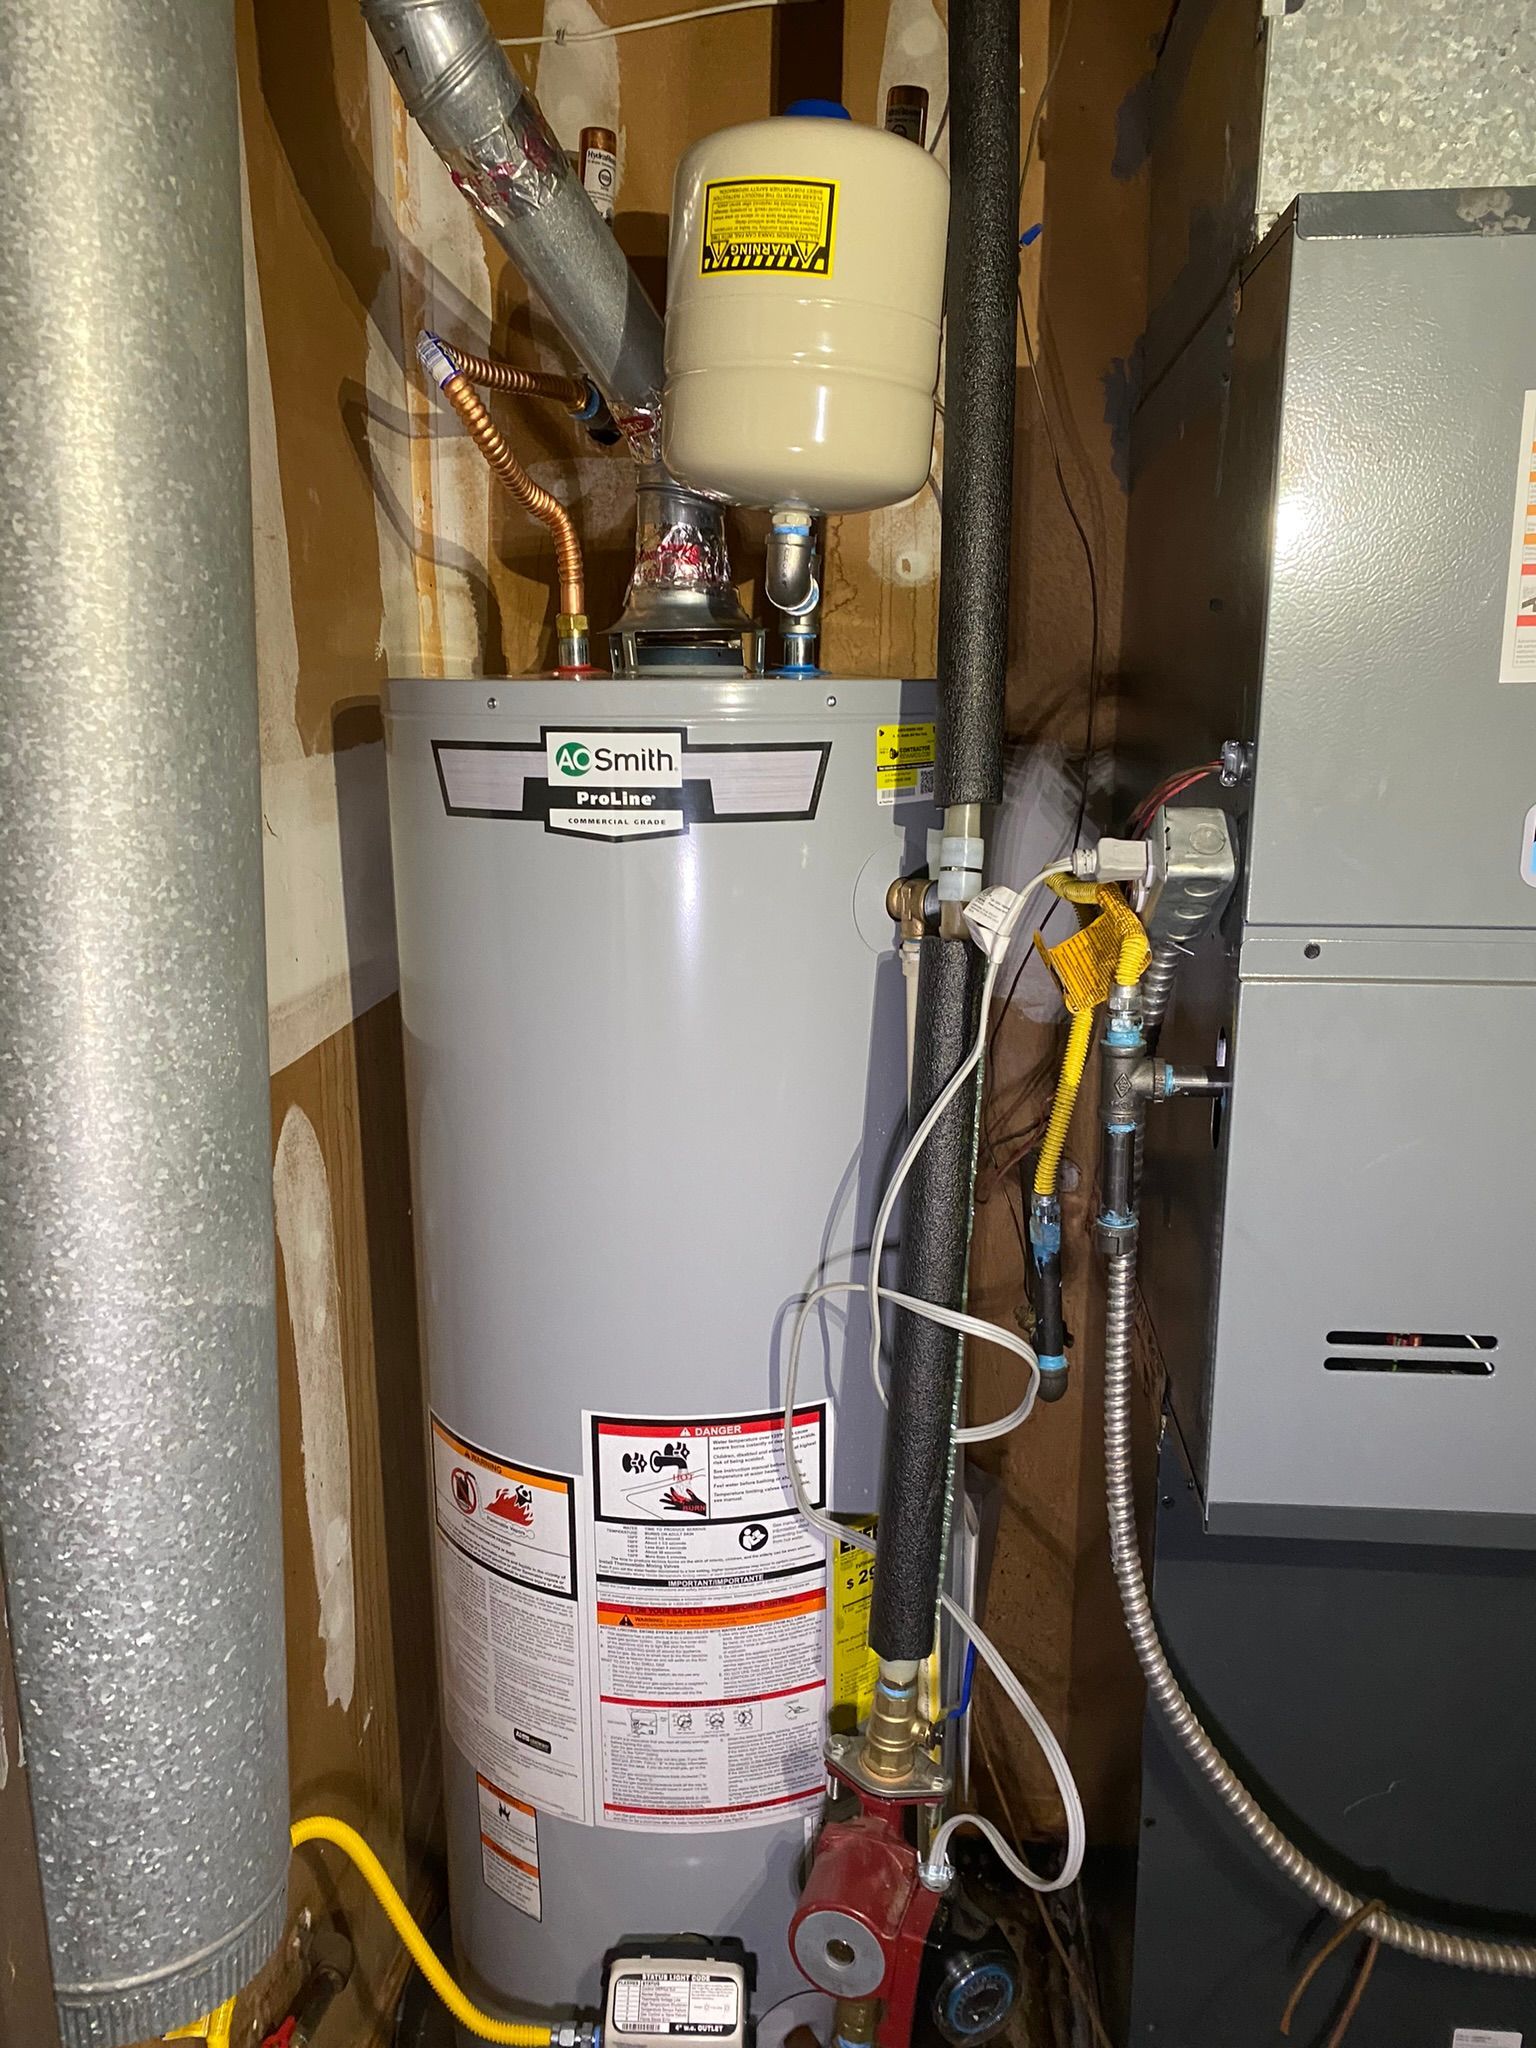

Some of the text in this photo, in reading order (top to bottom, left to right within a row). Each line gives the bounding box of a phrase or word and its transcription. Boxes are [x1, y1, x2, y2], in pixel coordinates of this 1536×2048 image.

[731, 243, 792, 256] WARNING
[899, 745, 931, 753] CONTRACTOR
[594, 748, 673, 771] Smith
[577, 791, 652, 806] ProLine
[695, 1425, 742, 1436] DANGER
[471, 1453, 502, 1474] WARNING
[672, 1473, 692, 1481] HOT
[668, 1574, 764, 1587] IMPORTANT/IMPORTANTE
